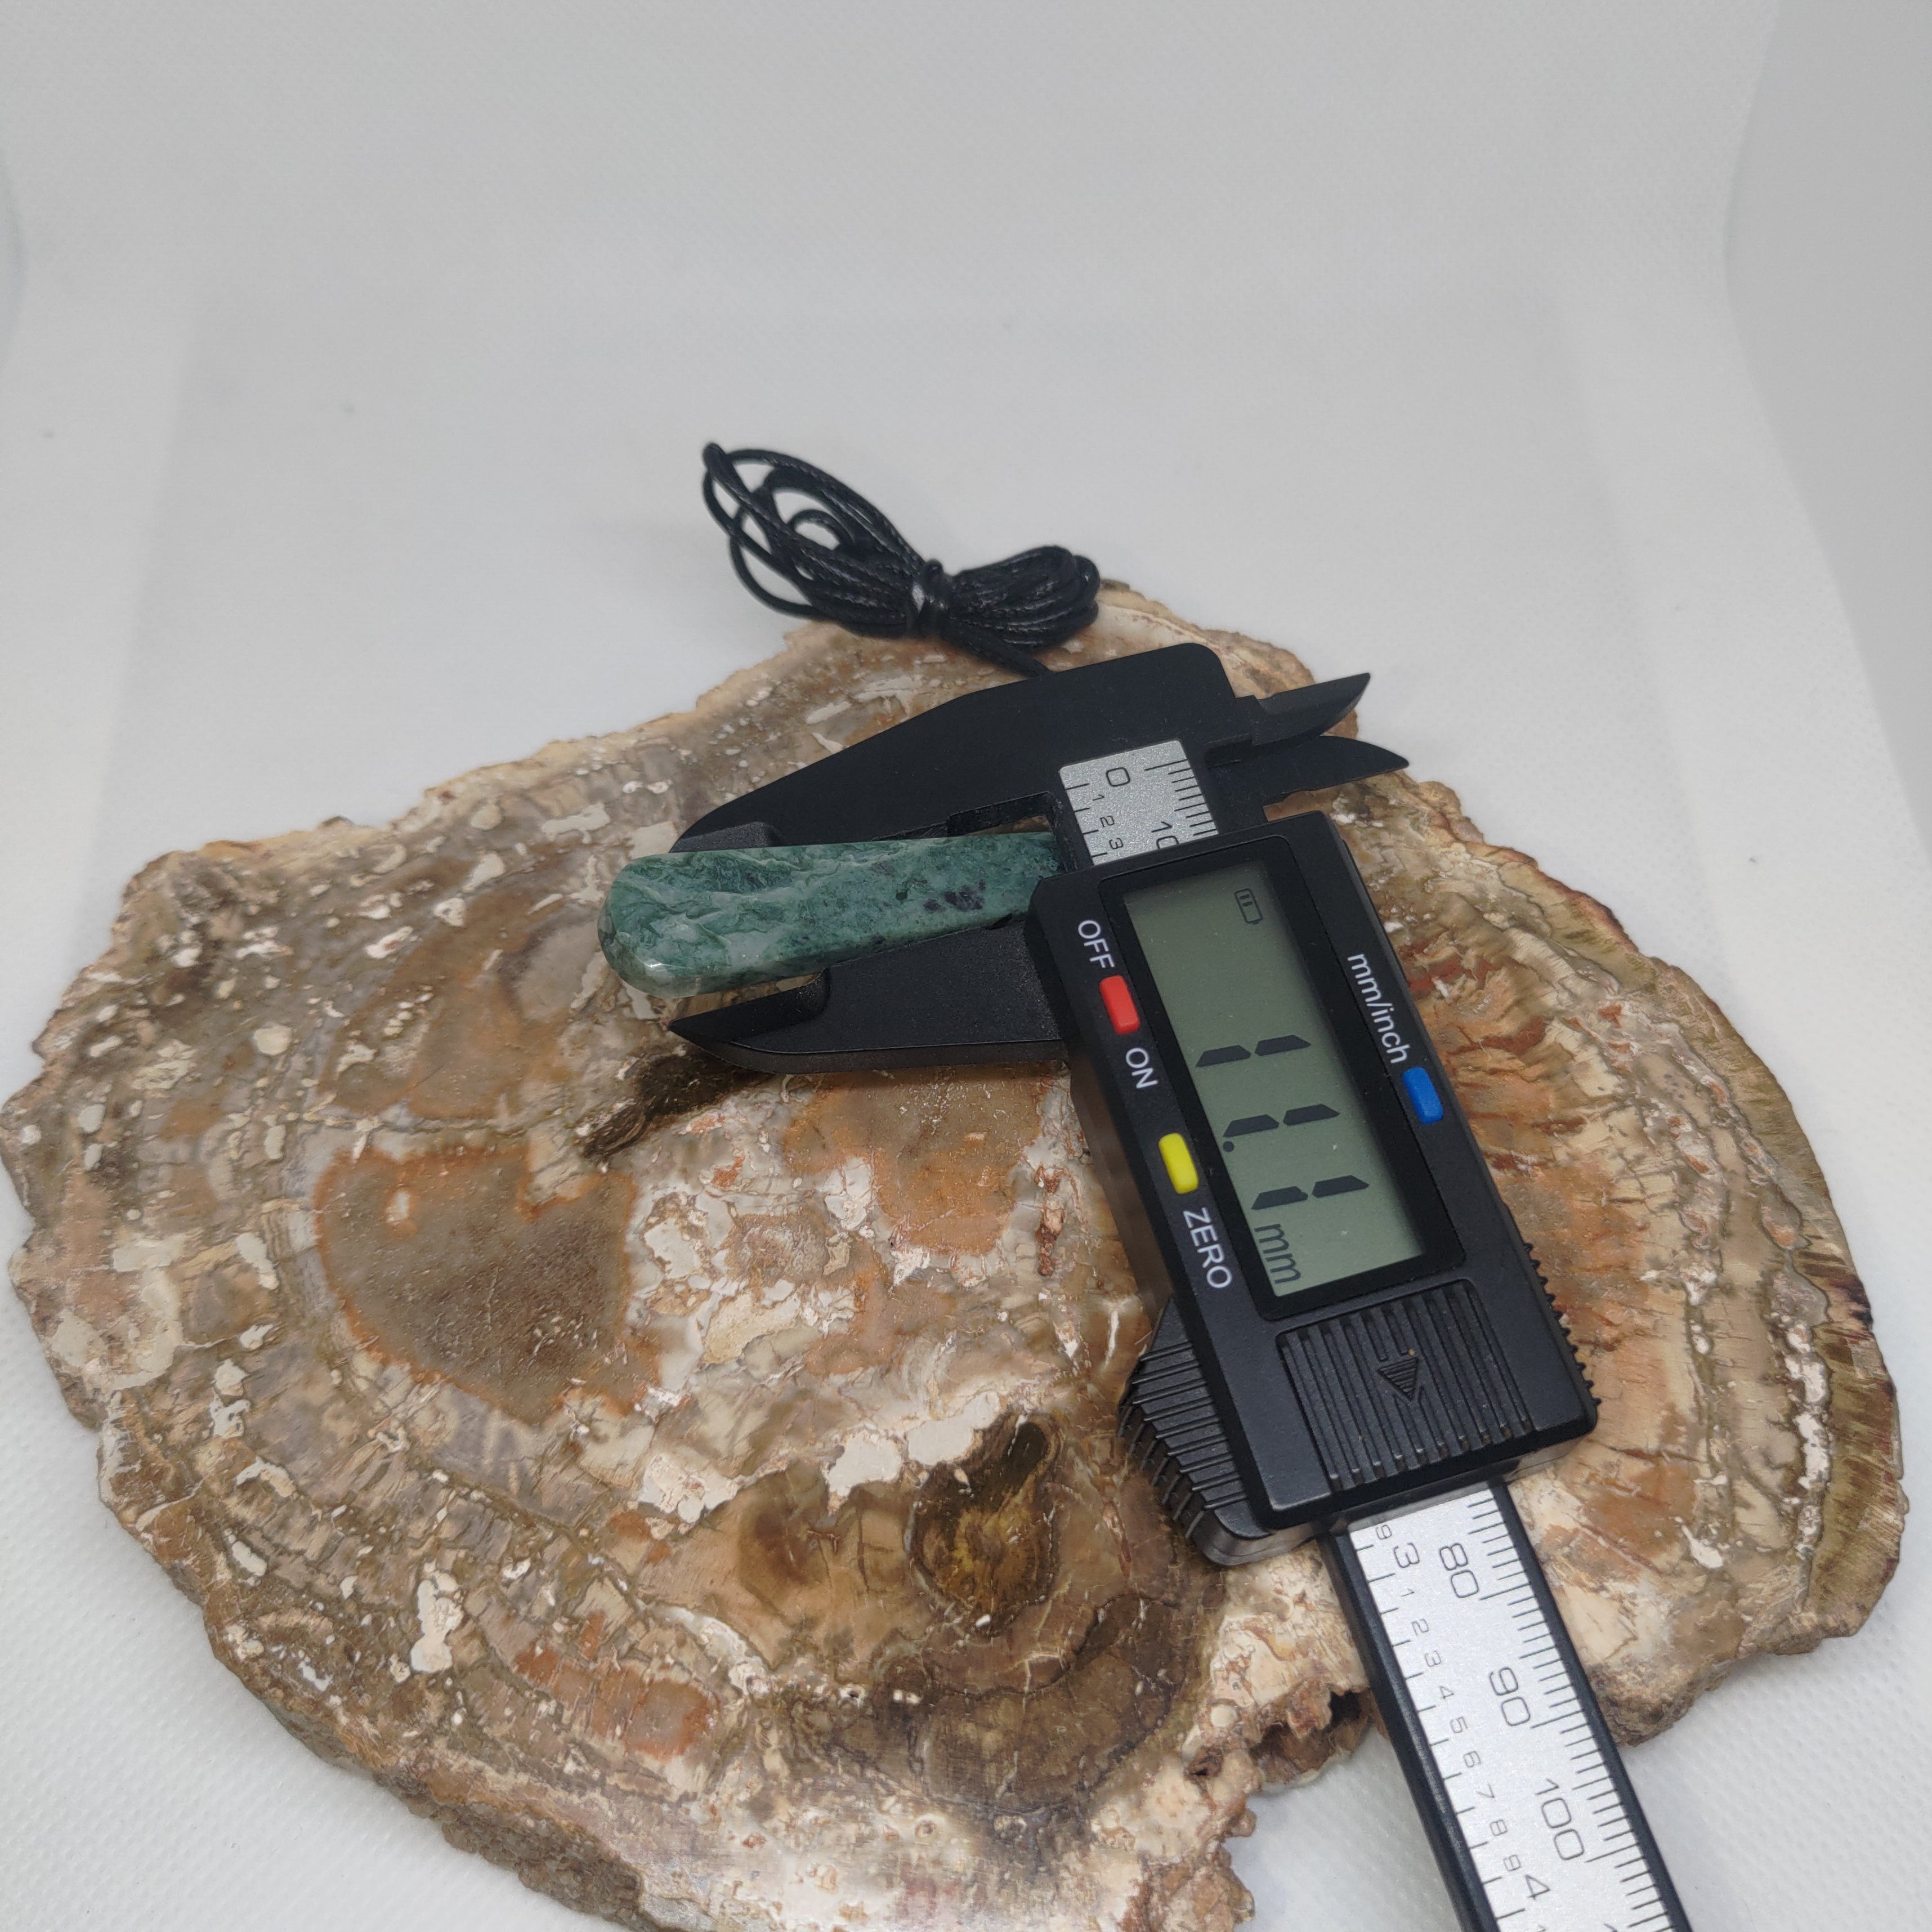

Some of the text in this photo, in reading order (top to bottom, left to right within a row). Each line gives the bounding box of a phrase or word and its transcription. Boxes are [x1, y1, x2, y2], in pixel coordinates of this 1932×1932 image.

[1105, 767, 1131, 787] 0
[1099, 815, 1115, 828] 2
[1108, 837, 1124, 850] 3
[1077, 919, 1115, 969] OFF
[1347, 953, 1410, 1064] mm/inch
[1125, 1047, 1159, 1089] ON
[1182, 1207, 1233, 1289] ZERO
[1254, 1223, 1301, 1284] mm
[1392, 1541, 1421, 1569] 3
[1400, 1587, 1415, 1598] 1
[1411, 1618, 1430, 1636] 2
[1424, 1650, 1442, 1667] 3
[1438, 1685, 1455, 1700] 4
[1438, 1542, 1586, 1862] 80 90 100
[1450, 1716, 1468, 1734] 5
[1463, 1750, 1482, 1768] 6
[1476, 1783, 1496, 1799] 7
[1489, 1818, 1509, 1837] 8
[1524, 1874, 1551, 1901] 4
